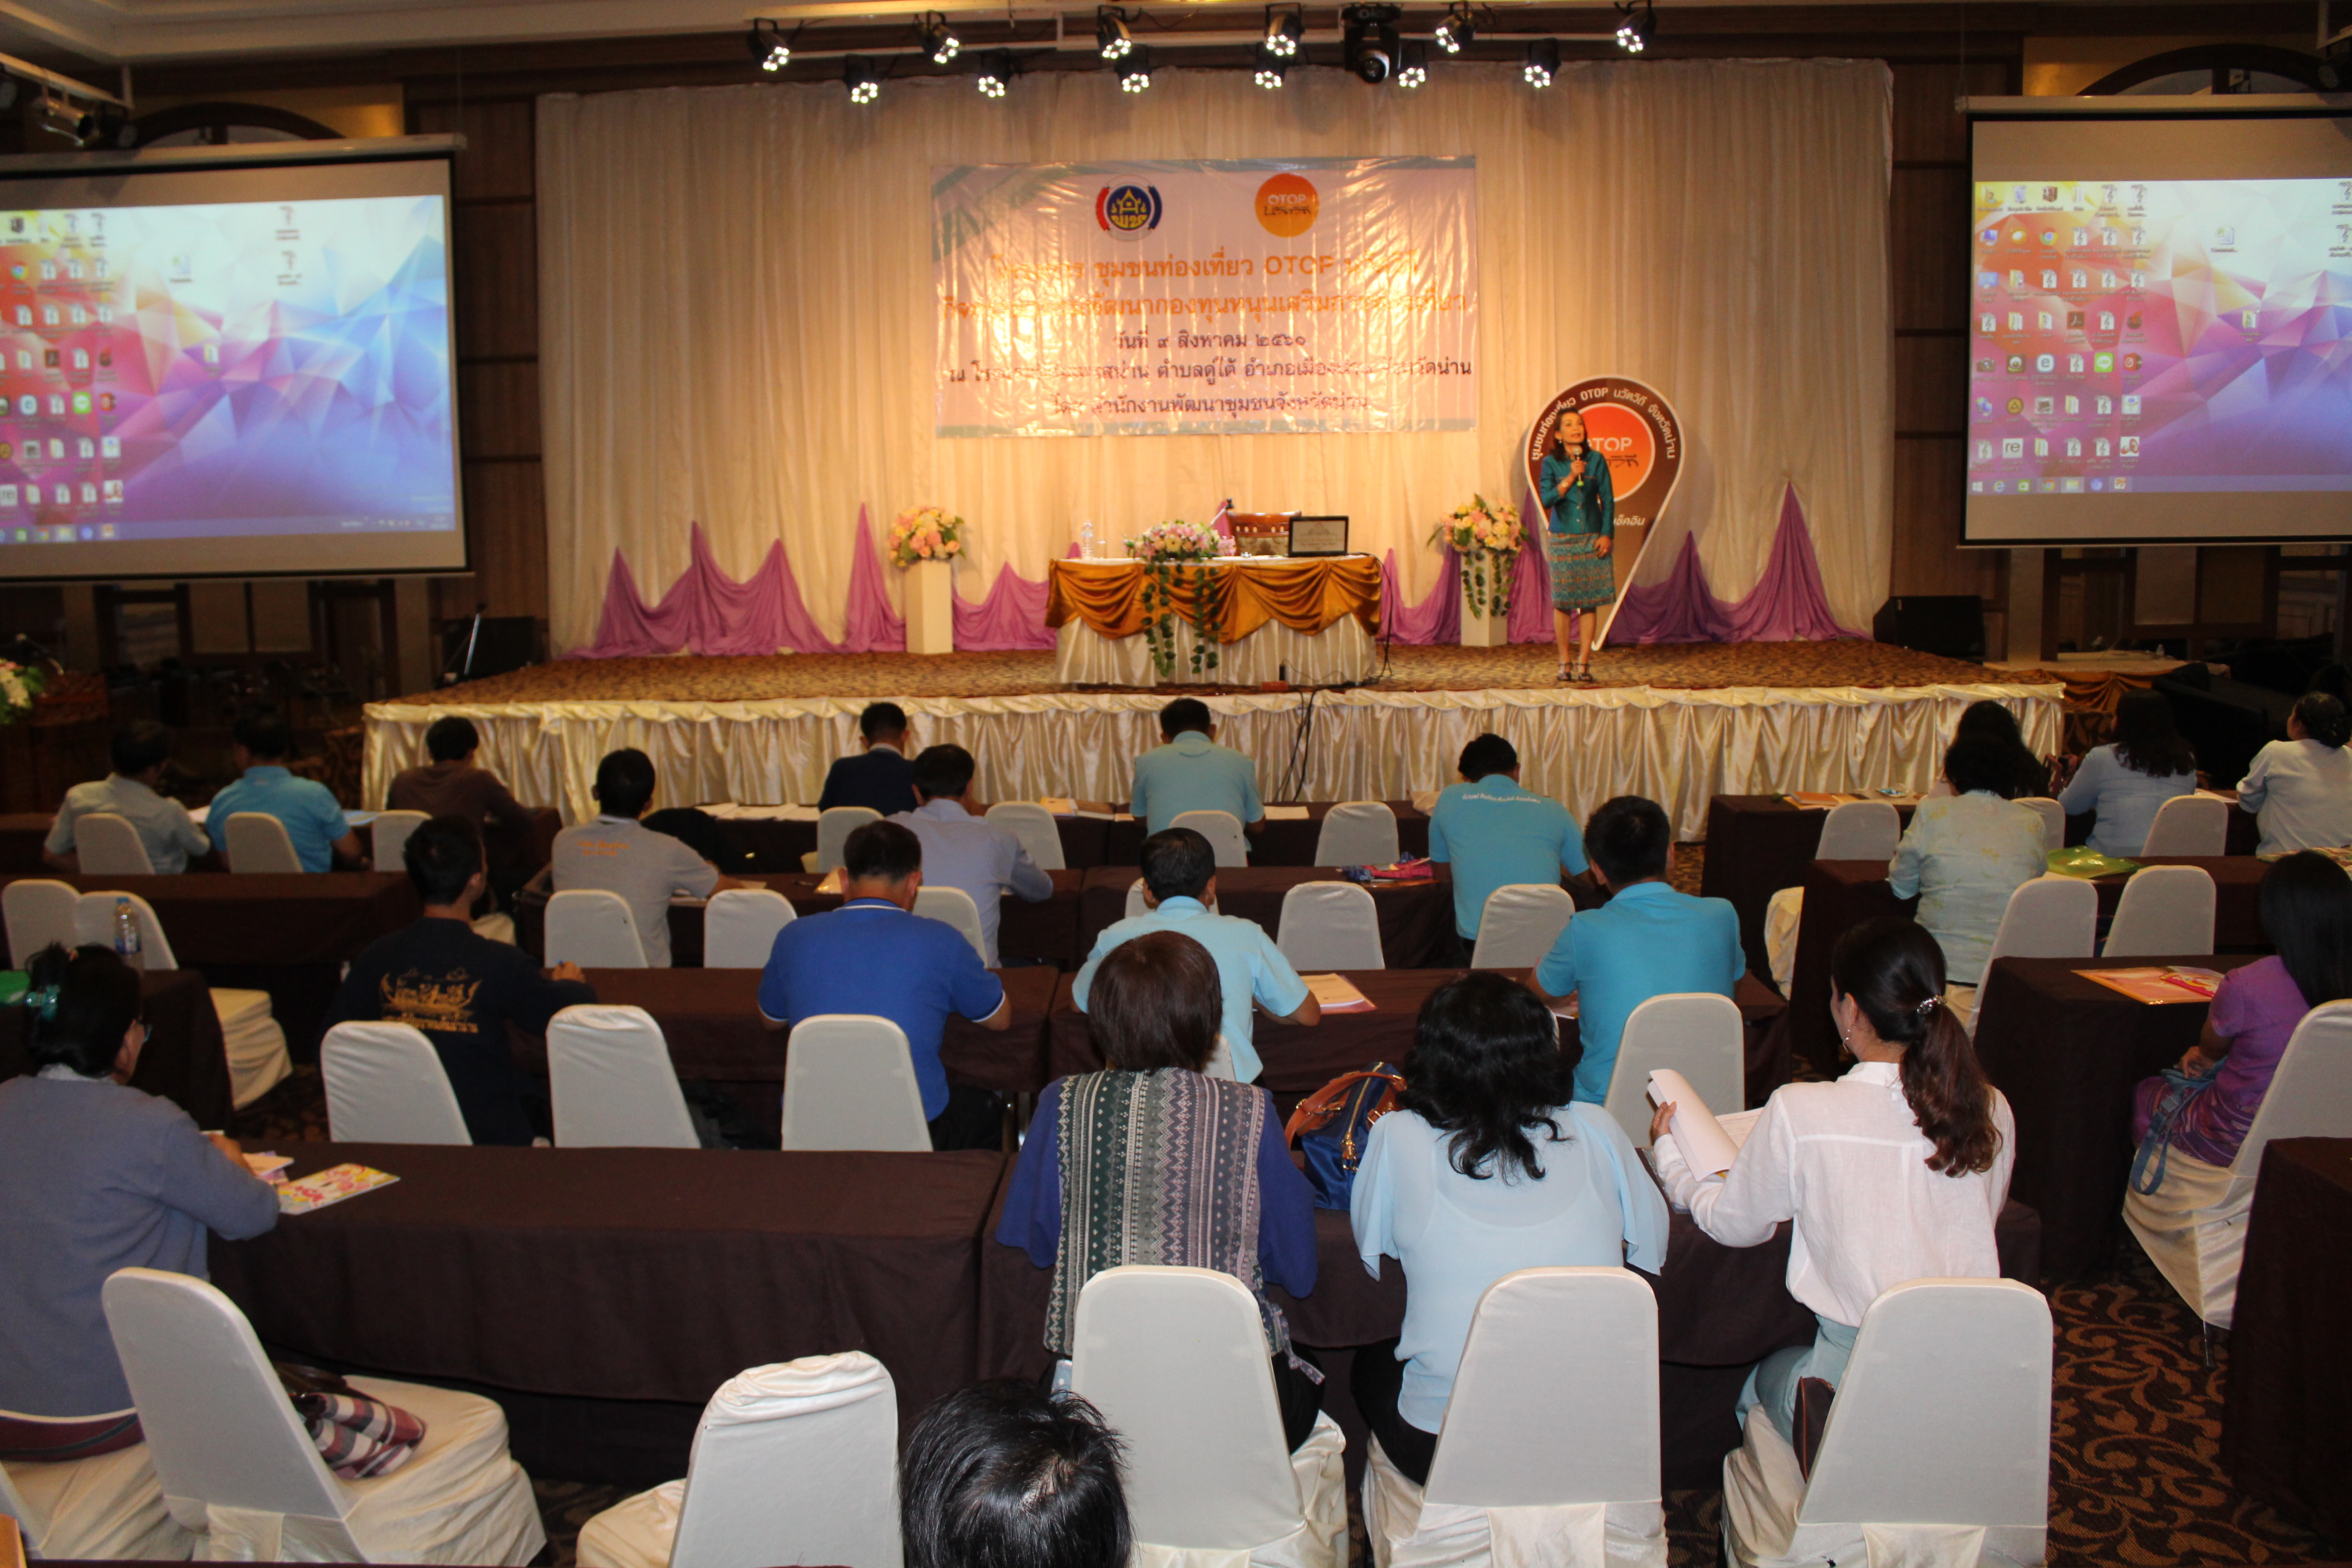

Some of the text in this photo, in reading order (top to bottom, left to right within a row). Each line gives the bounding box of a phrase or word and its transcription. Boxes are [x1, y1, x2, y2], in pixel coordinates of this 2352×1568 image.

[1268, 194, 1306, 205] OTOP
[1094, 246, 1253, 287] ชุมชนท่องเที่ยว
[1265, 255, 1334, 275] OTOP
[1178, 329, 1246, 348] สิงหาคม
[1579, 387, 1609, 401] OTOP
[1587, 436, 1633, 451] TOP
